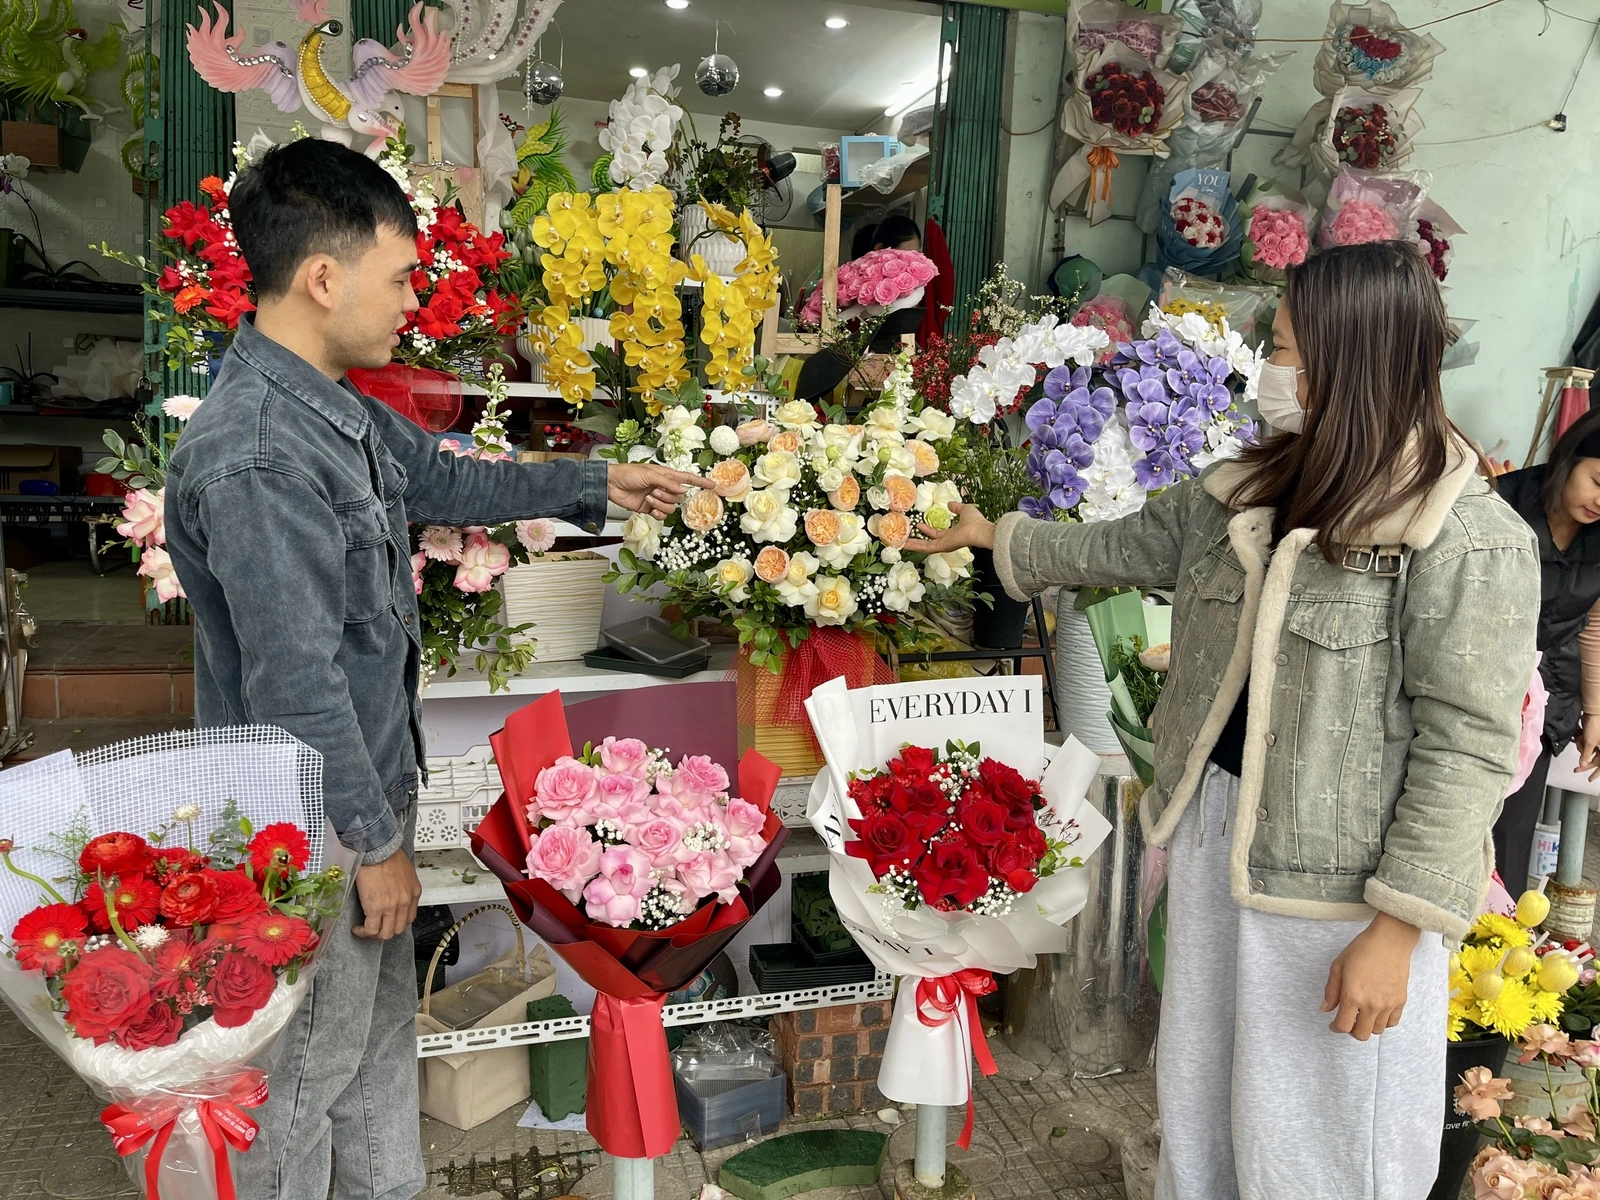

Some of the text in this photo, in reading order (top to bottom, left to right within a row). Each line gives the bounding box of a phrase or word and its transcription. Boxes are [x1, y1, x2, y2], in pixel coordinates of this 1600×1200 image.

[1198, 173, 1225, 187] YOU
[869, 688, 1033, 725] EVERYDAY I
